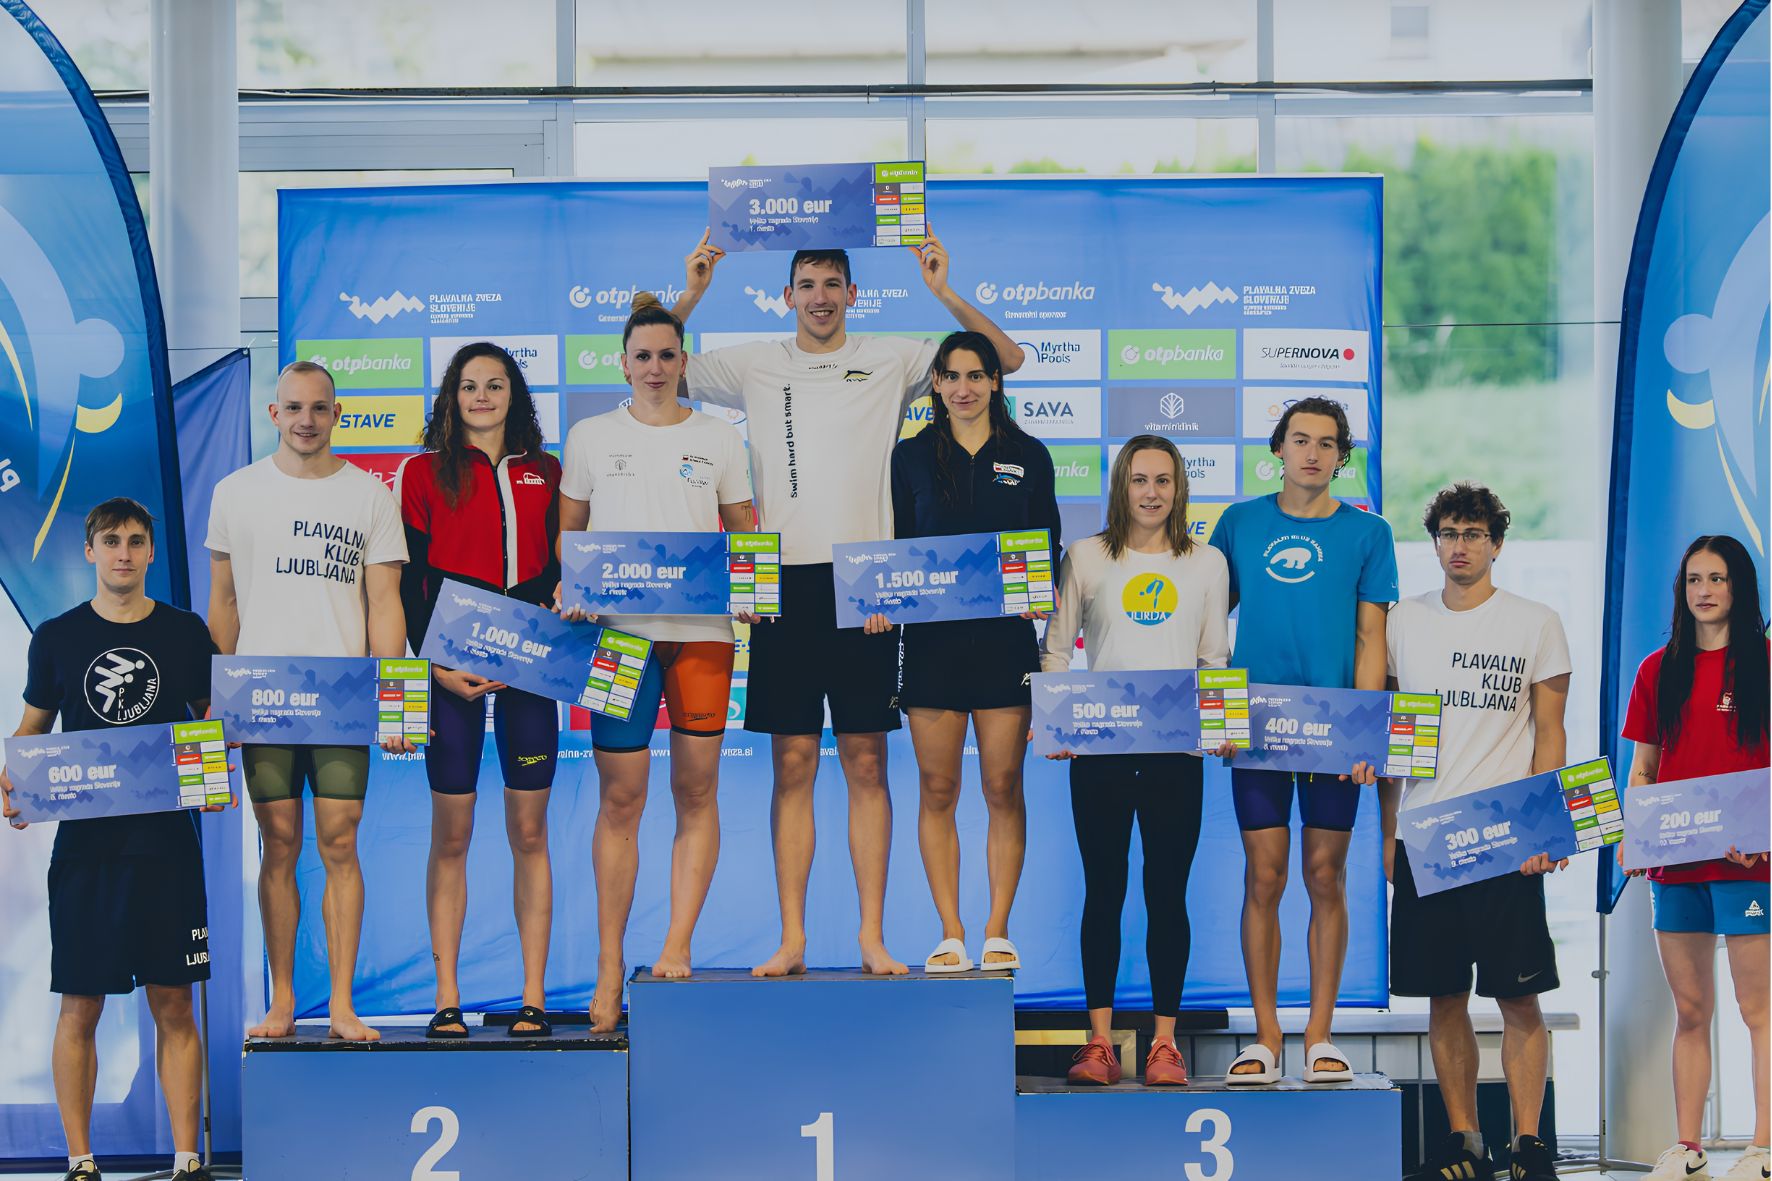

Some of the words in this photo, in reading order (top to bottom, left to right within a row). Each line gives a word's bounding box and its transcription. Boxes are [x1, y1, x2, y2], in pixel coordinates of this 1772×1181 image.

[749, 198, 798, 215] 3.000
[803, 200, 832, 213] eur
[475, 293, 502, 302] ZVEZA
[1002, 281, 1095, 306] otpbanka
[1041, 342, 1080, 354] Myrtha
[1041, 353, 1071, 363] Pools
[1145, 344, 1224, 366] otpbanka
[1261, 347, 1340, 359] SUPERNOVA
[332, 354, 411, 376] otpbanka
[1024, 401, 1074, 417] SAVA
[784, 420, 793, 438] but
[787, 441, 796, 466] hard
[790, 469, 798, 499] Swim
[294, 520, 365, 549] PLAVALNI
[325, 543, 360, 566] KLUB
[276, 557, 355, 584] LJUBLJANA
[602, 563, 652, 579] 2.000
[656, 566, 686, 579] eur
[875, 570, 924, 589] 1.500
[929, 570, 959, 585] eur
[472, 622, 519, 649] 1.000
[521, 640, 552, 658] eur
[1452, 652, 1526, 674] PLAVALNI
[1482, 673, 1521, 693] KLUB
[117, 677, 157, 721] LJUBLJANA
[251, 689, 285, 706] 800
[289, 693, 319, 706] eur
[1072, 703, 1106, 719] 500
[1110, 704, 1140, 718] eur
[1265, 717, 1299, 734] 400
[1302, 722, 1332, 736] eur
[48, 765, 83, 783] 600
[87, 765, 117, 780] eur
[1660, 811, 1690, 829] 200
[1694, 809, 1722, 825] eur
[1445, 827, 1479, 850] 300
[1483, 821, 1511, 840] eur
[411, 1106, 460, 1181] 2
[801, 1112, 834, 1181] 1
[1184, 1108, 1234, 1181] 3
